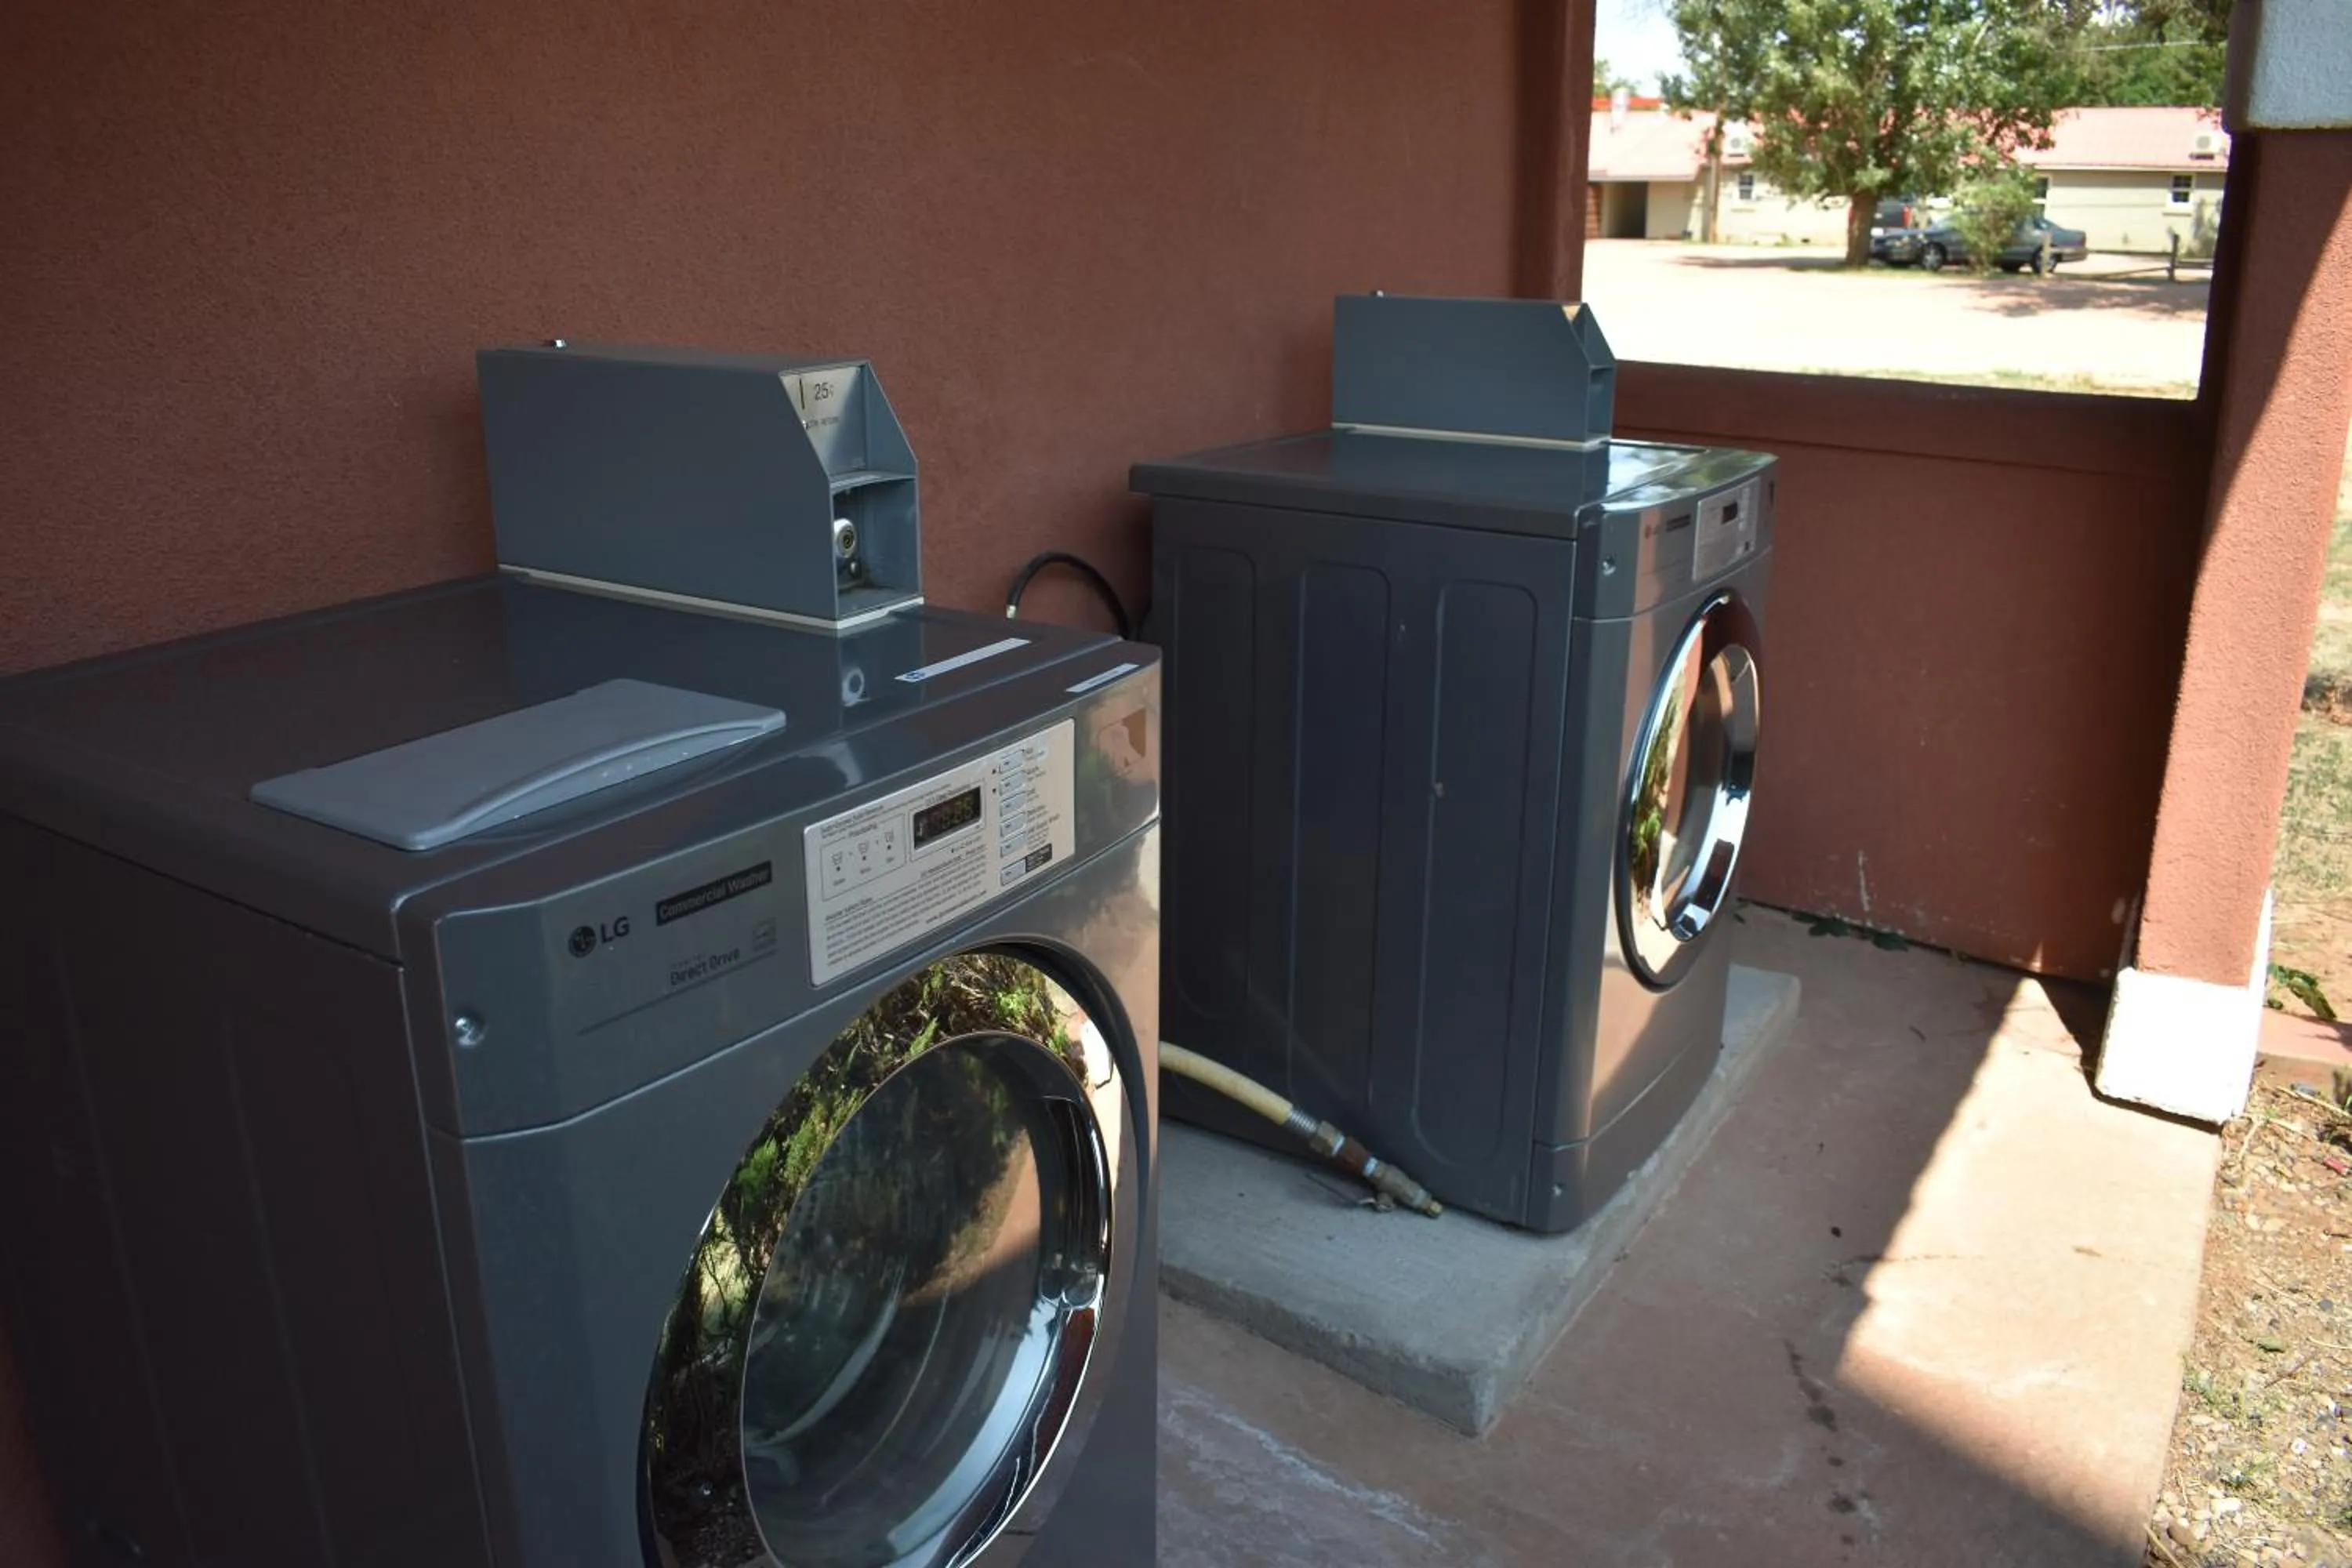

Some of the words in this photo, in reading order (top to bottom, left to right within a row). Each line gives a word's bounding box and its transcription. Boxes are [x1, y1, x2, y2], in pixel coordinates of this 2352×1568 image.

[600, 916, 630, 944] LG
[670, 963, 706, 985] Direct
[709, 948, 740, 972] Drive
